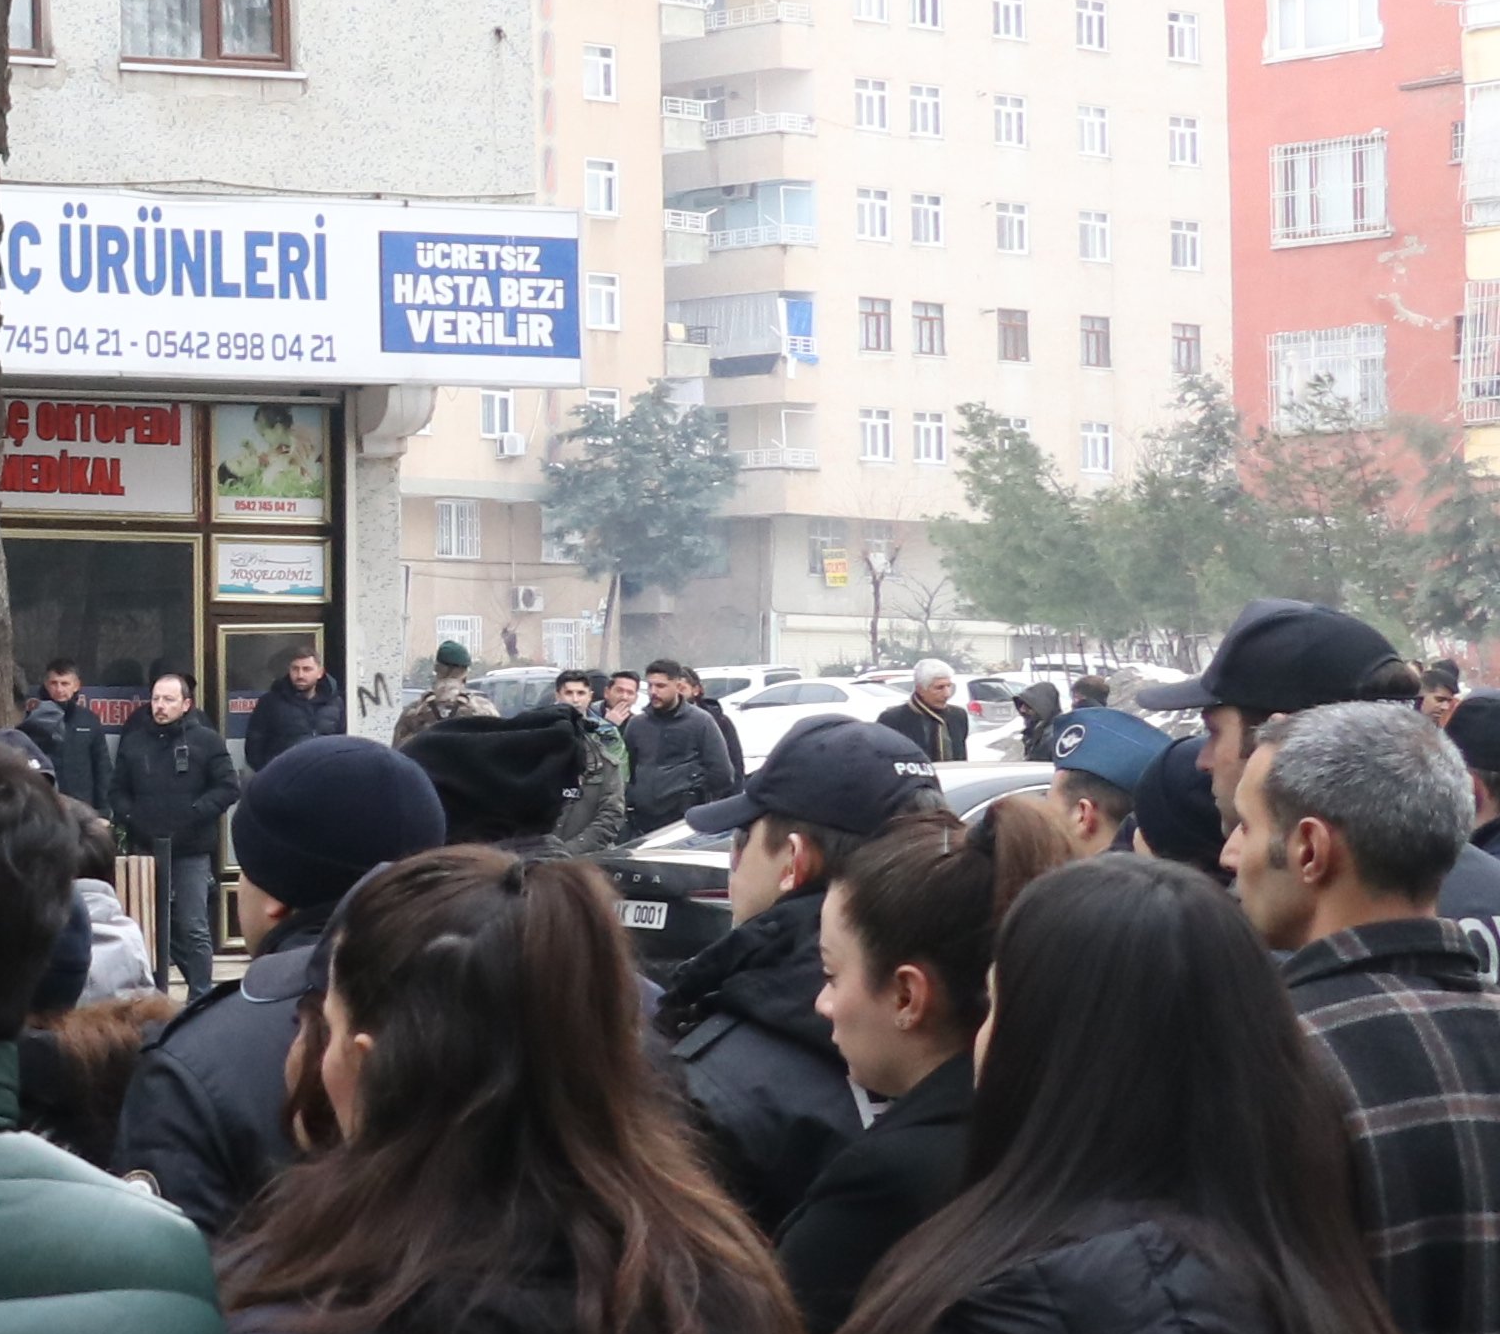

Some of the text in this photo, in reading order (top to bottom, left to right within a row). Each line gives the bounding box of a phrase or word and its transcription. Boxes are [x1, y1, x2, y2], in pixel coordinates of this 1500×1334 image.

[59, 202, 328, 301] ÜRÜNLERİ
[416, 242, 541, 273] ÜCRETSİZ
[393, 273, 565, 310] HASTA BEZİ
[2, 325, 49, 355] 745
[55, 326, 90, 355] 04
[95, 328, 124, 357] 21
[145, 330, 211, 360] 0542
[216, 332, 265, 361] 898
[271, 333, 304, 362] 04
[310, 334, 337, 363] 21
[405, 309, 554, 348] VERİLİR
[35, 401, 182, 446] ORTOPEDİ
[633, 905, 663, 925] 0001
